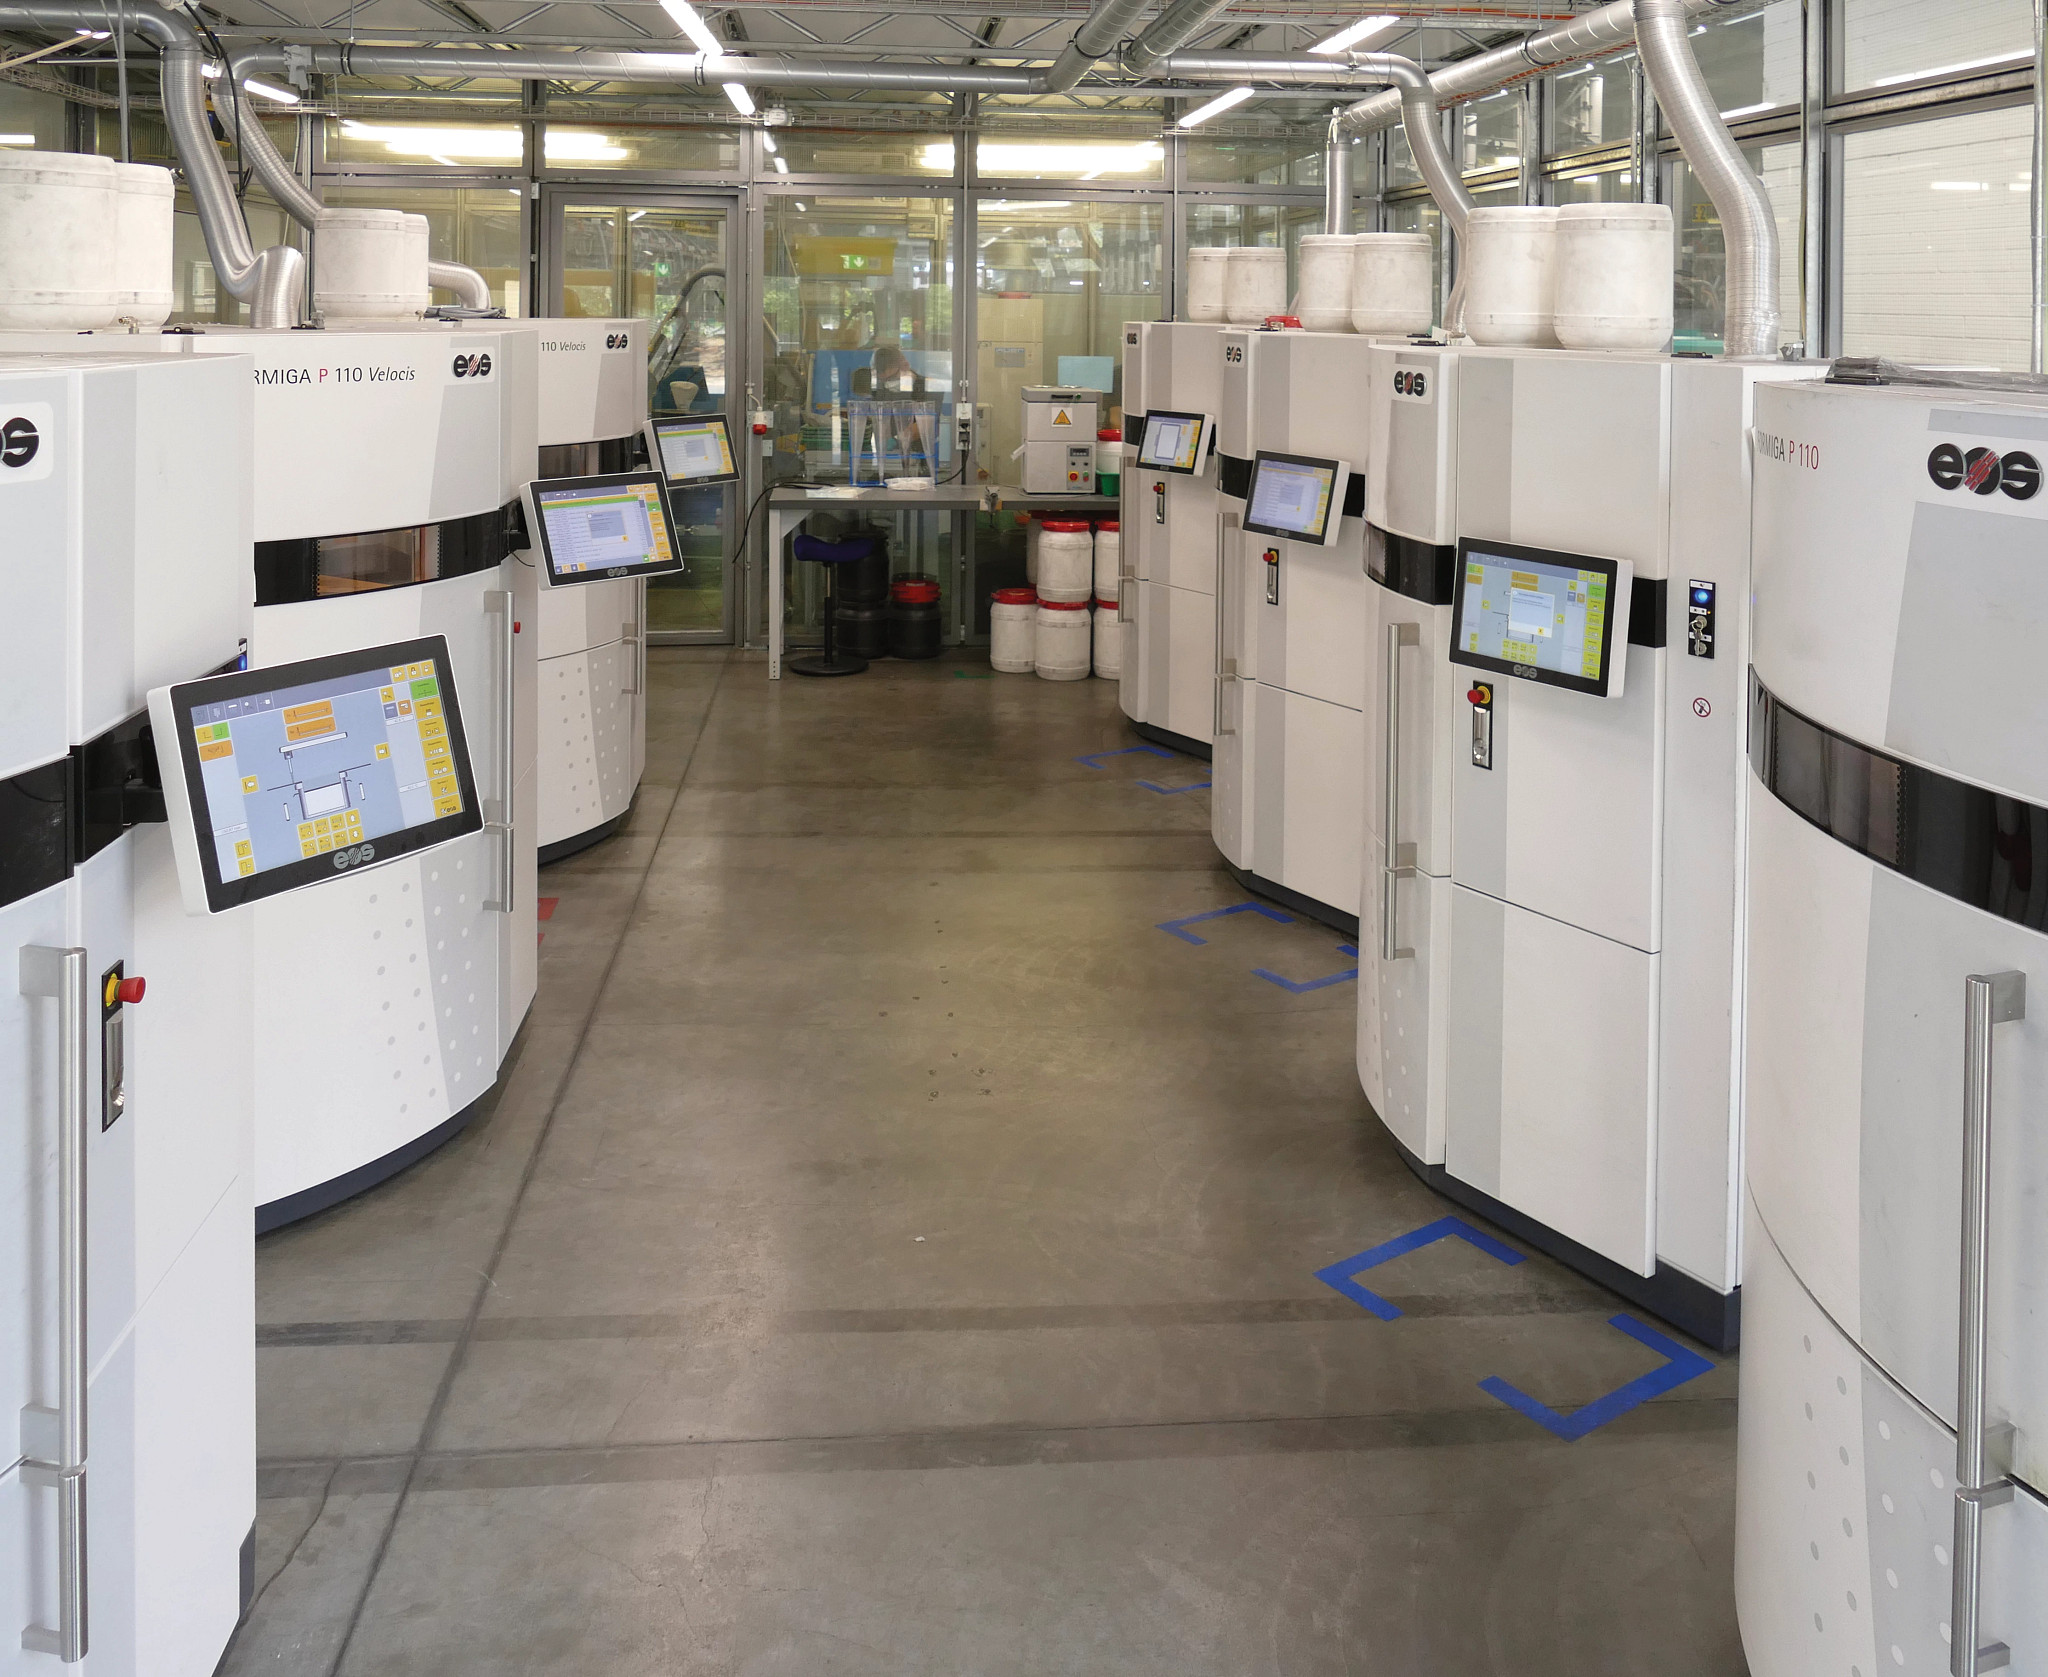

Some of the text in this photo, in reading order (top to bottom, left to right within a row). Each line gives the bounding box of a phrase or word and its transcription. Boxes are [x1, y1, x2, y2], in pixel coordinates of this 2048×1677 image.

[541, 340, 586, 351] 110 Velocis
[319, 368, 329, 383] P
[335, 367, 363, 382] 110
[368, 366, 416, 381] Velocis
[452, 354, 491, 378] eos
[1393, 370, 1428, 397] eos
[1788, 440, 1796, 464] P
[1799, 443, 1819, 470] 110
[1927, 443, 2044, 501] eos
[333, 843, 375, 870] eos
